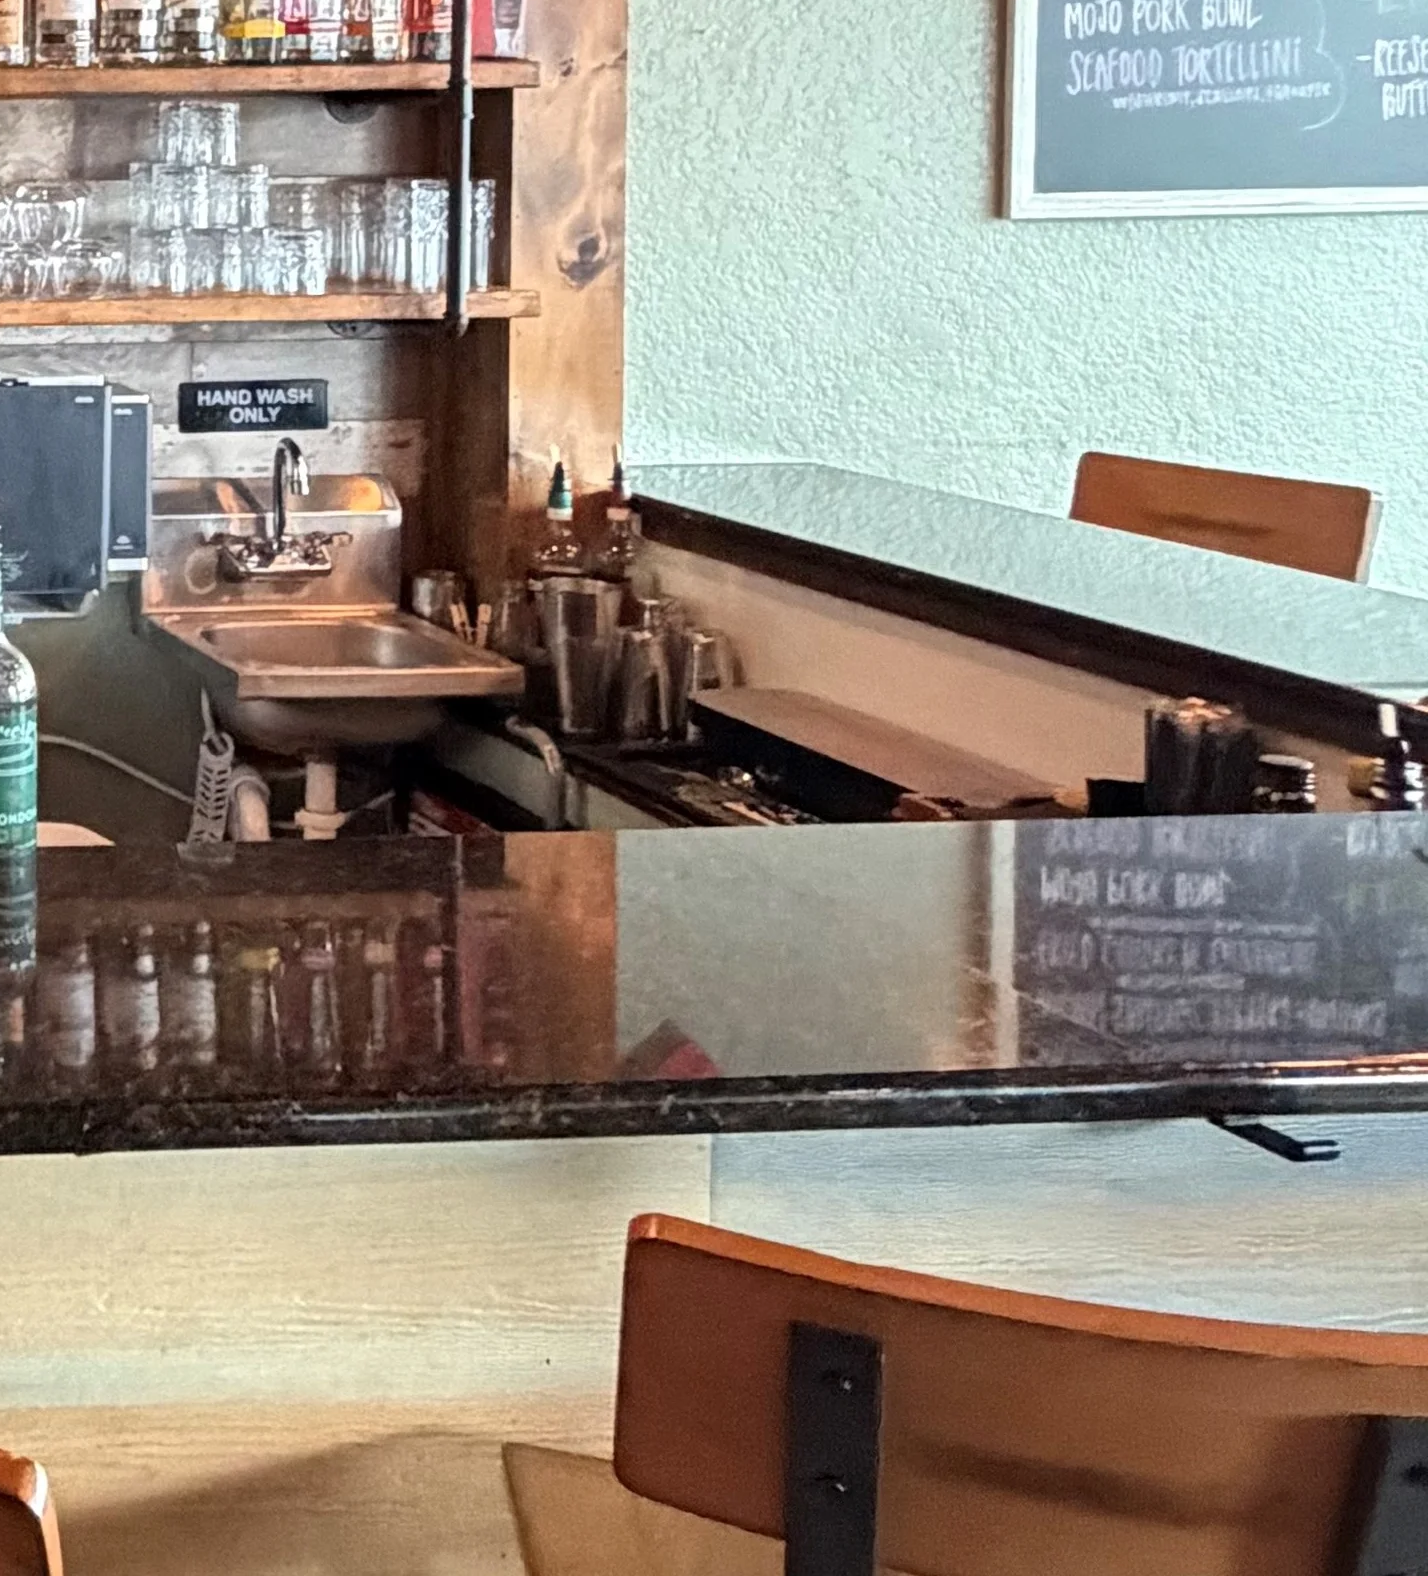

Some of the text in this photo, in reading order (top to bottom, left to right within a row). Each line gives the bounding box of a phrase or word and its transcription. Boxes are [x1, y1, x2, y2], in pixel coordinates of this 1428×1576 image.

[1066, 46, 1163, 96] SEAFOOD
[197, 387, 314, 407] HAND WASH
[228, 405, 281, 423] ONLY
